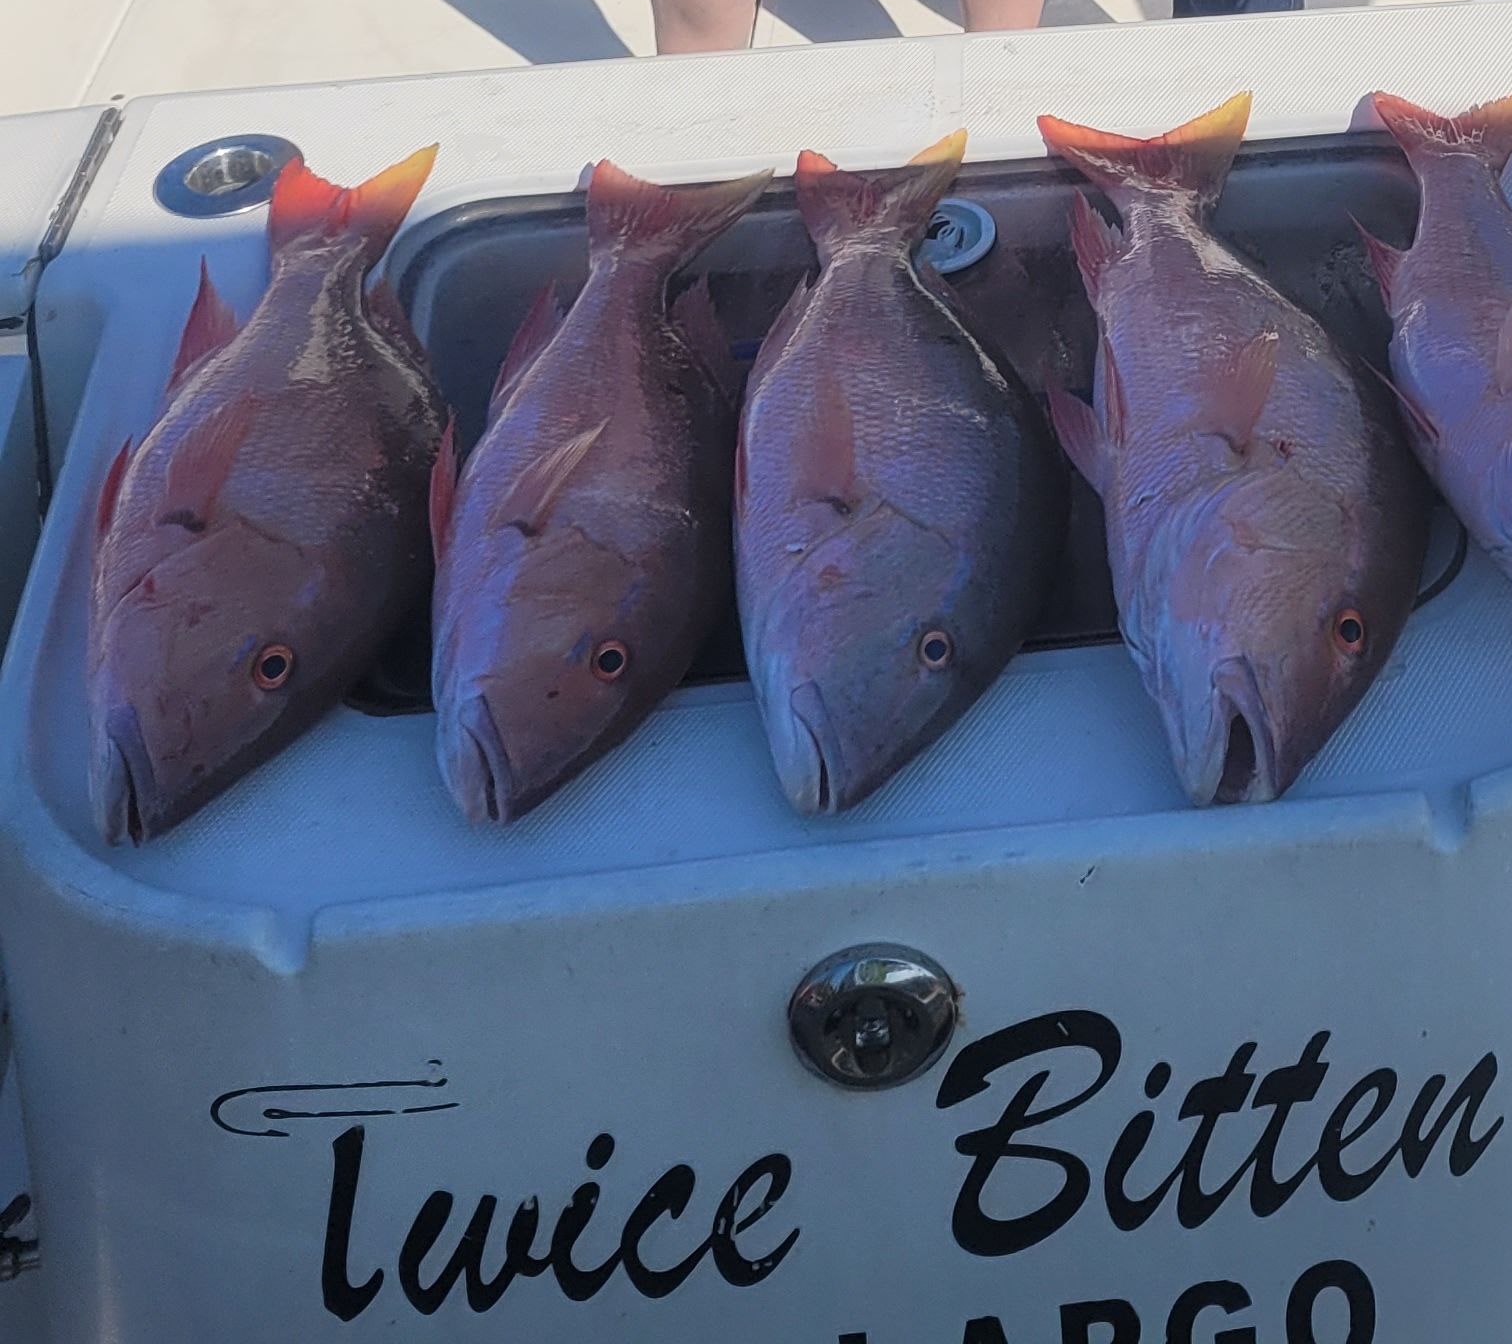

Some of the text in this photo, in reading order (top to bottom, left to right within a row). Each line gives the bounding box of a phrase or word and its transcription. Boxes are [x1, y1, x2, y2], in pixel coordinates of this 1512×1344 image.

[322, 1009, 1504, 1323] Twice Bitten
[838, 1259, 1376, 1344] RGO
